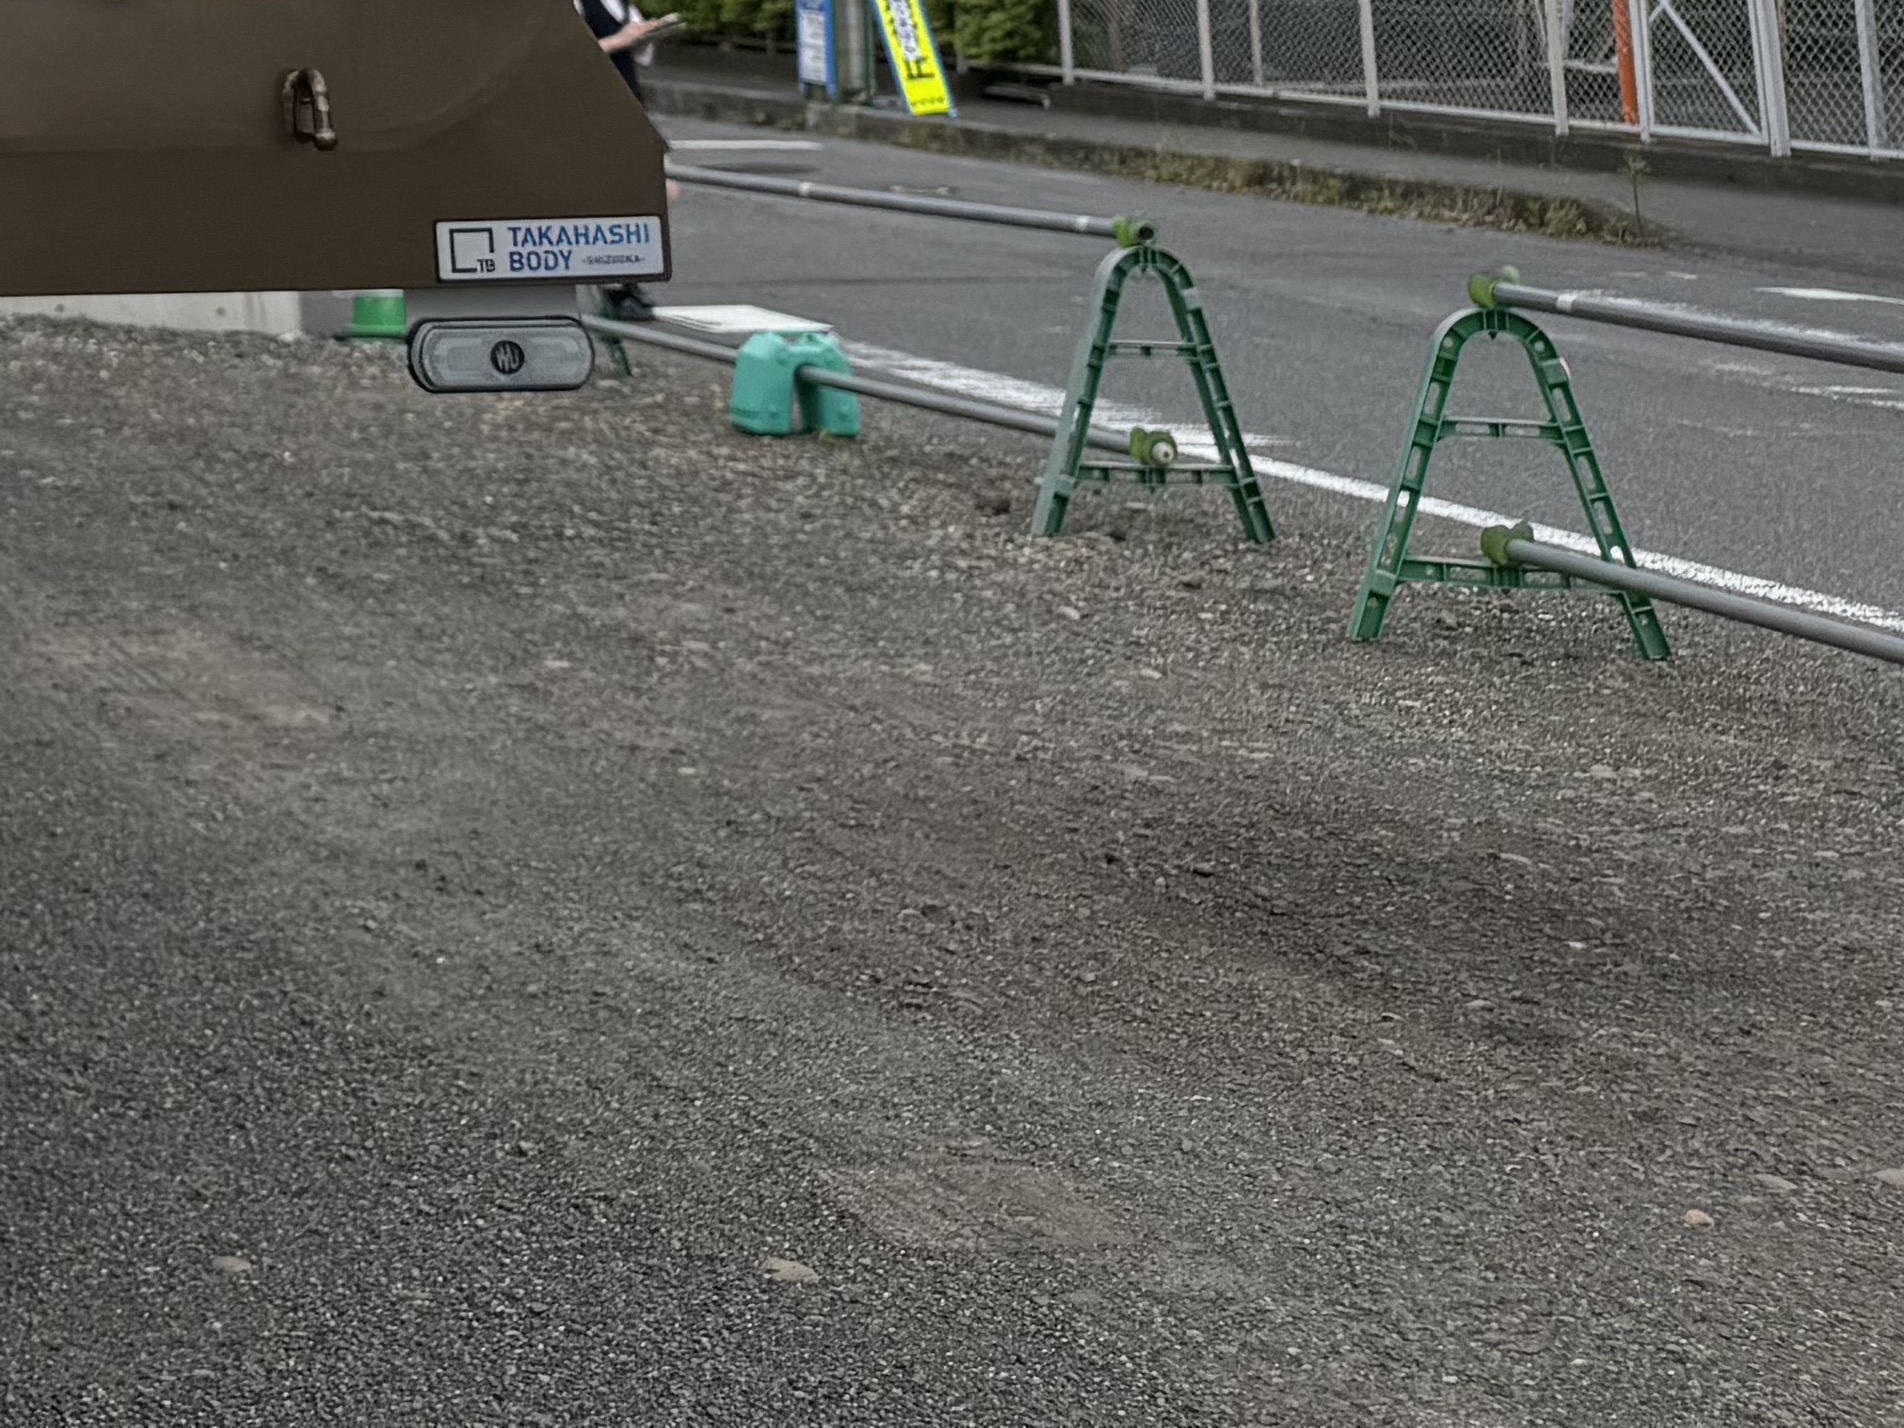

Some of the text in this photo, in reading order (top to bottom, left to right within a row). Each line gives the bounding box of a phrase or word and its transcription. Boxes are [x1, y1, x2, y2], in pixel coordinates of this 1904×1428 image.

[507, 223, 651, 247] TAKAHASHI
[476, 258, 496, 273] TB
[508, 249, 573, 272] BODY
